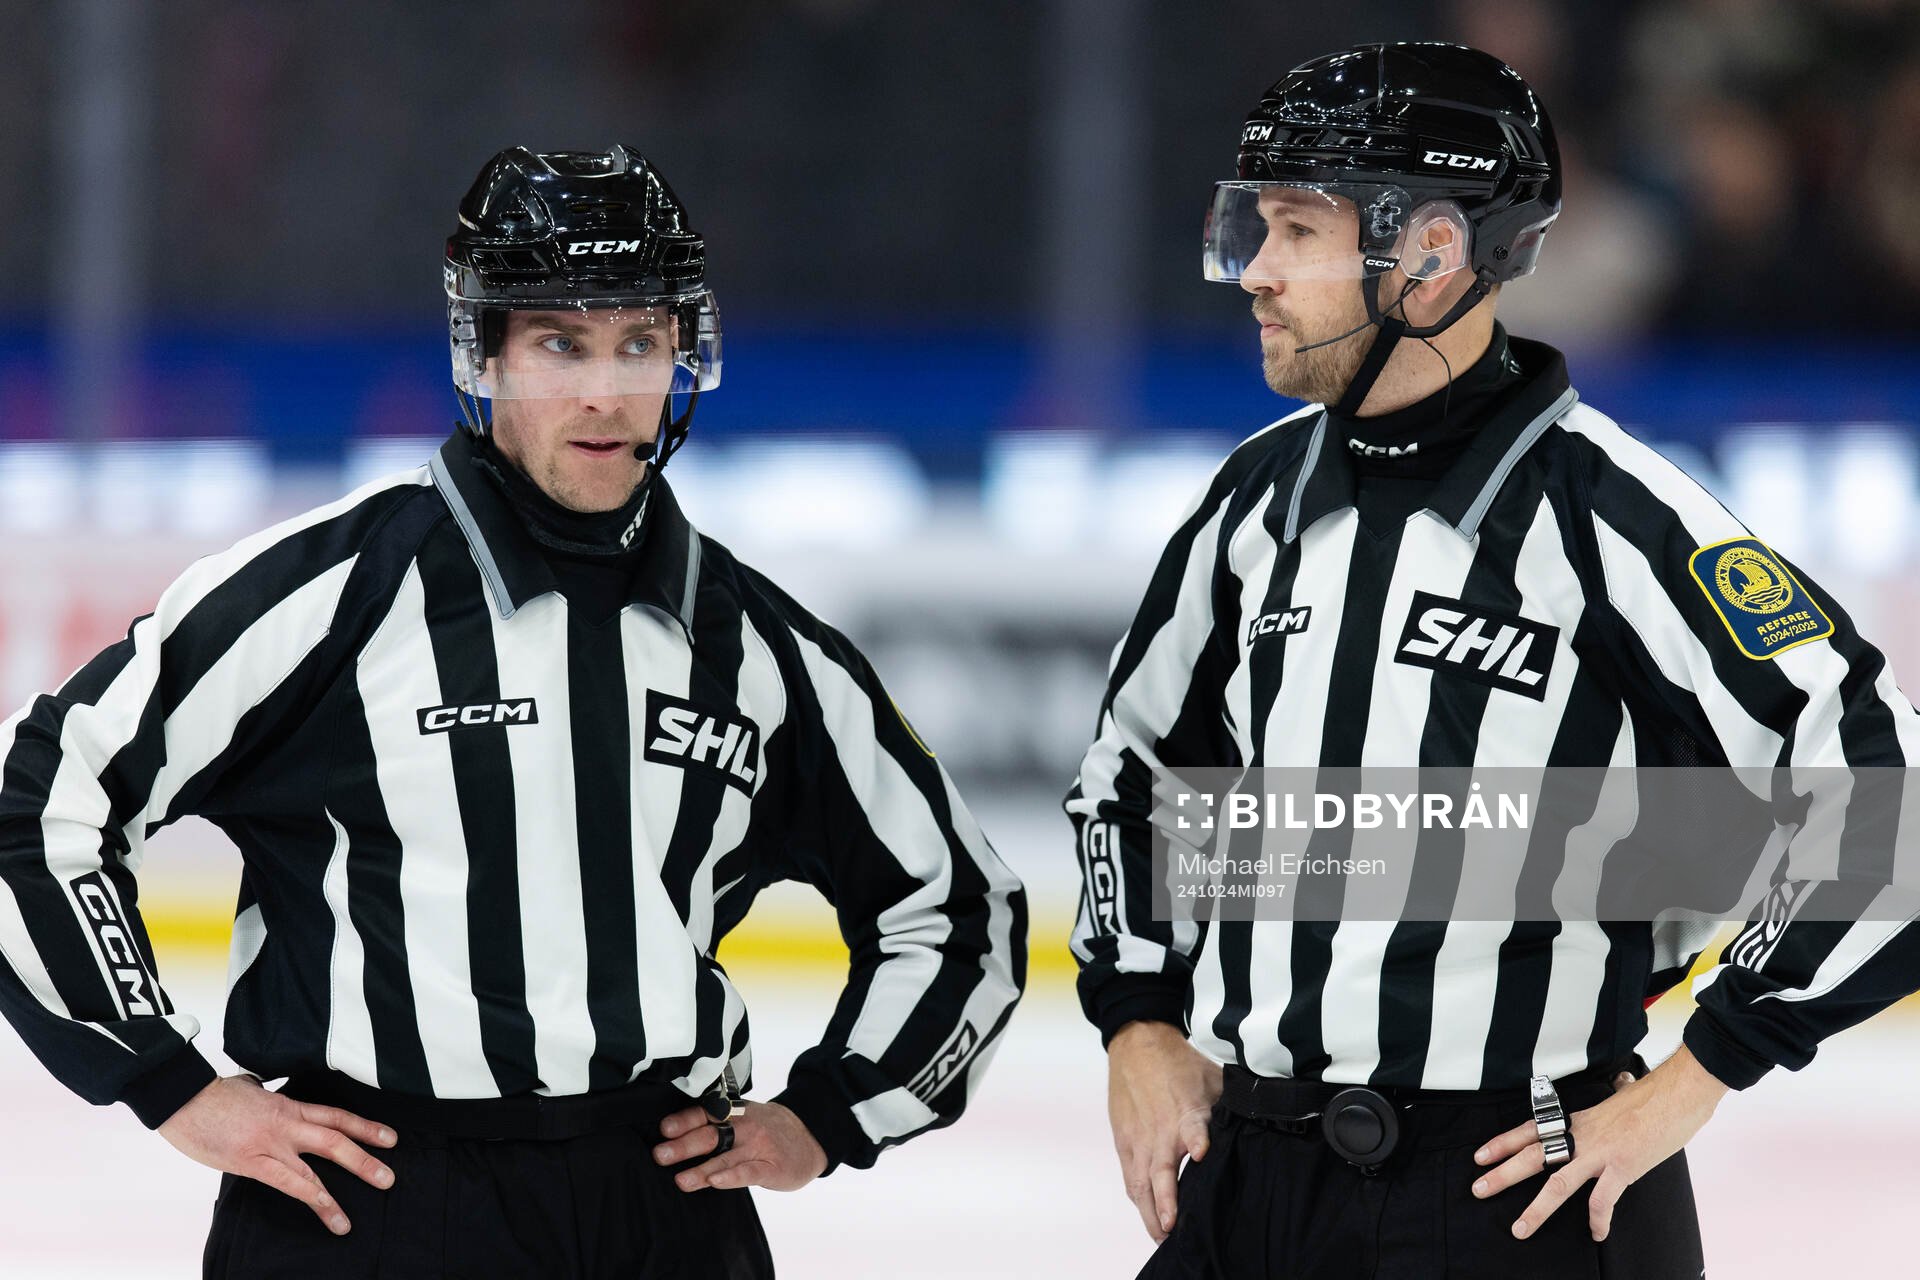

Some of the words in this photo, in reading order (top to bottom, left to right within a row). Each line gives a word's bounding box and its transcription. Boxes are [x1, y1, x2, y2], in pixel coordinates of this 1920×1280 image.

[1423, 151, 1497, 171] CCM
[567, 240, 641, 255] CCM
[1366, 259, 1395, 269] CCM
[1249, 610, 1309, 642] CCM
[1756, 611, 1811, 636] REFEREE
[1763, 620, 1818, 647] 2024/2025
[1402, 607, 1544, 686] SHL
[424, 702, 532, 730] CCM
[649, 706, 757, 784] SHL
[78, 883, 156, 1016] CCM
